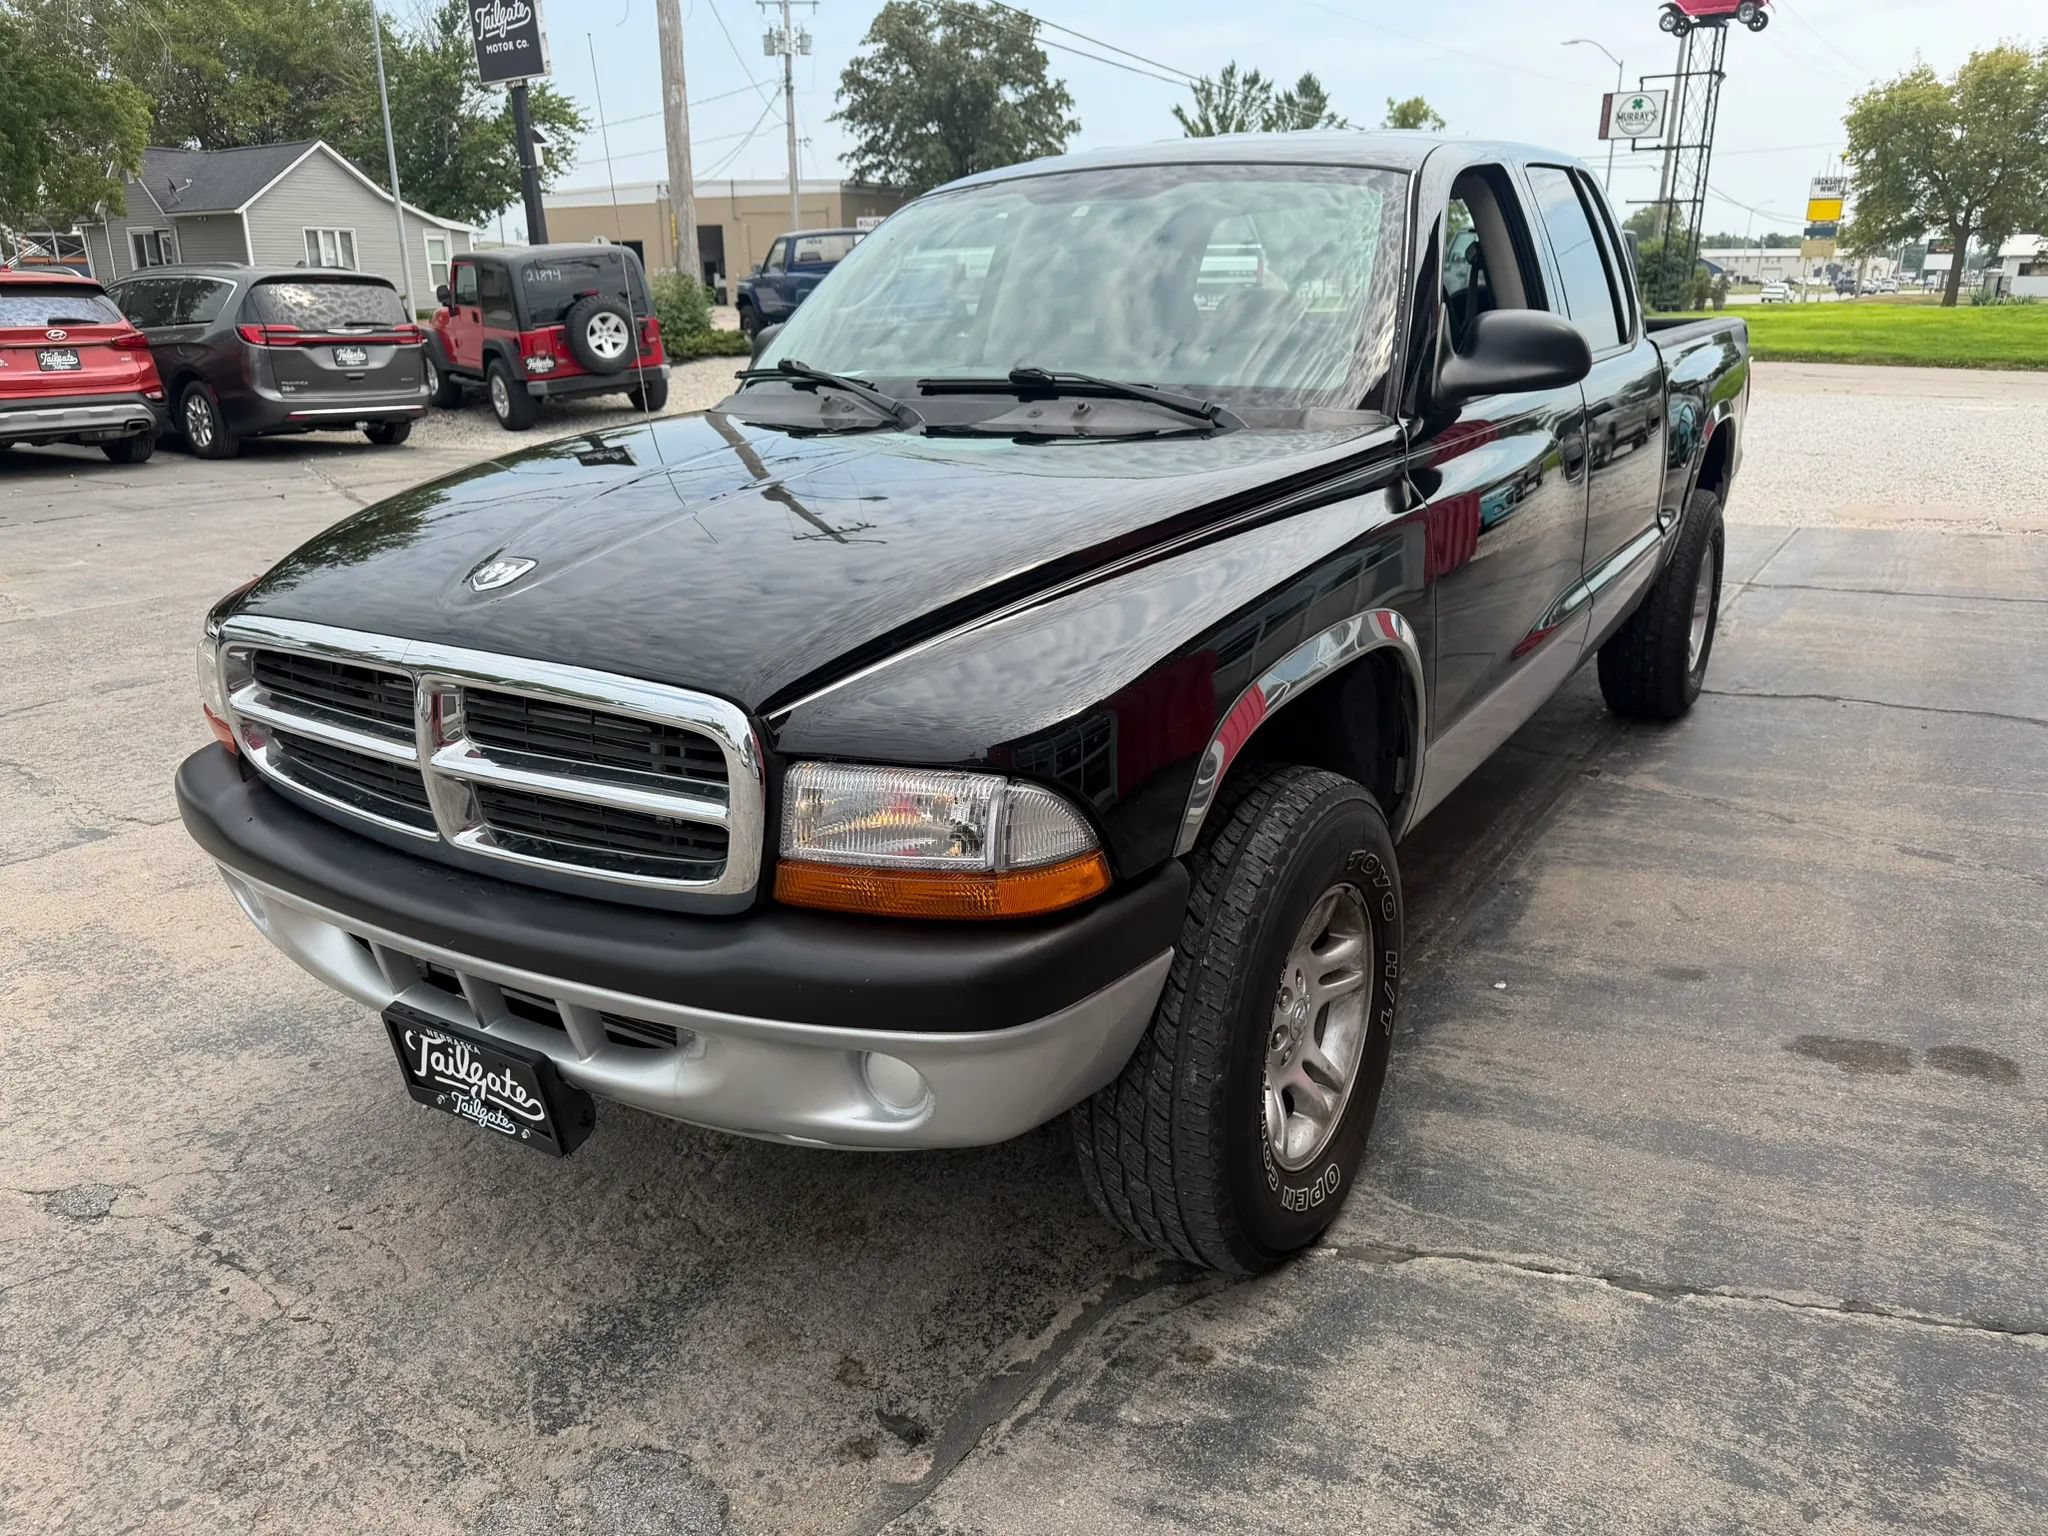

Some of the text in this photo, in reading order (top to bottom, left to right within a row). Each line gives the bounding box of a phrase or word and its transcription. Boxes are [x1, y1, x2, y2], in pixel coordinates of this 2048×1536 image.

[474, 0, 532, 40] Tailgate
[486, 41, 514, 54] MOTOR
[1616, 110, 1658, 122] MURRAY'S
[40, 350, 78, 366] Tailgate
[1346, 850, 1397, 922] TOYO
[1380, 951, 1398, 1037] H/T
[426, 1028, 481, 1055] NEBRASKA
[404, 1029, 545, 1121] Tailgate
[451, 1091, 516, 1134] Tailgate
[1281, 1163, 1340, 1212] OPEN
